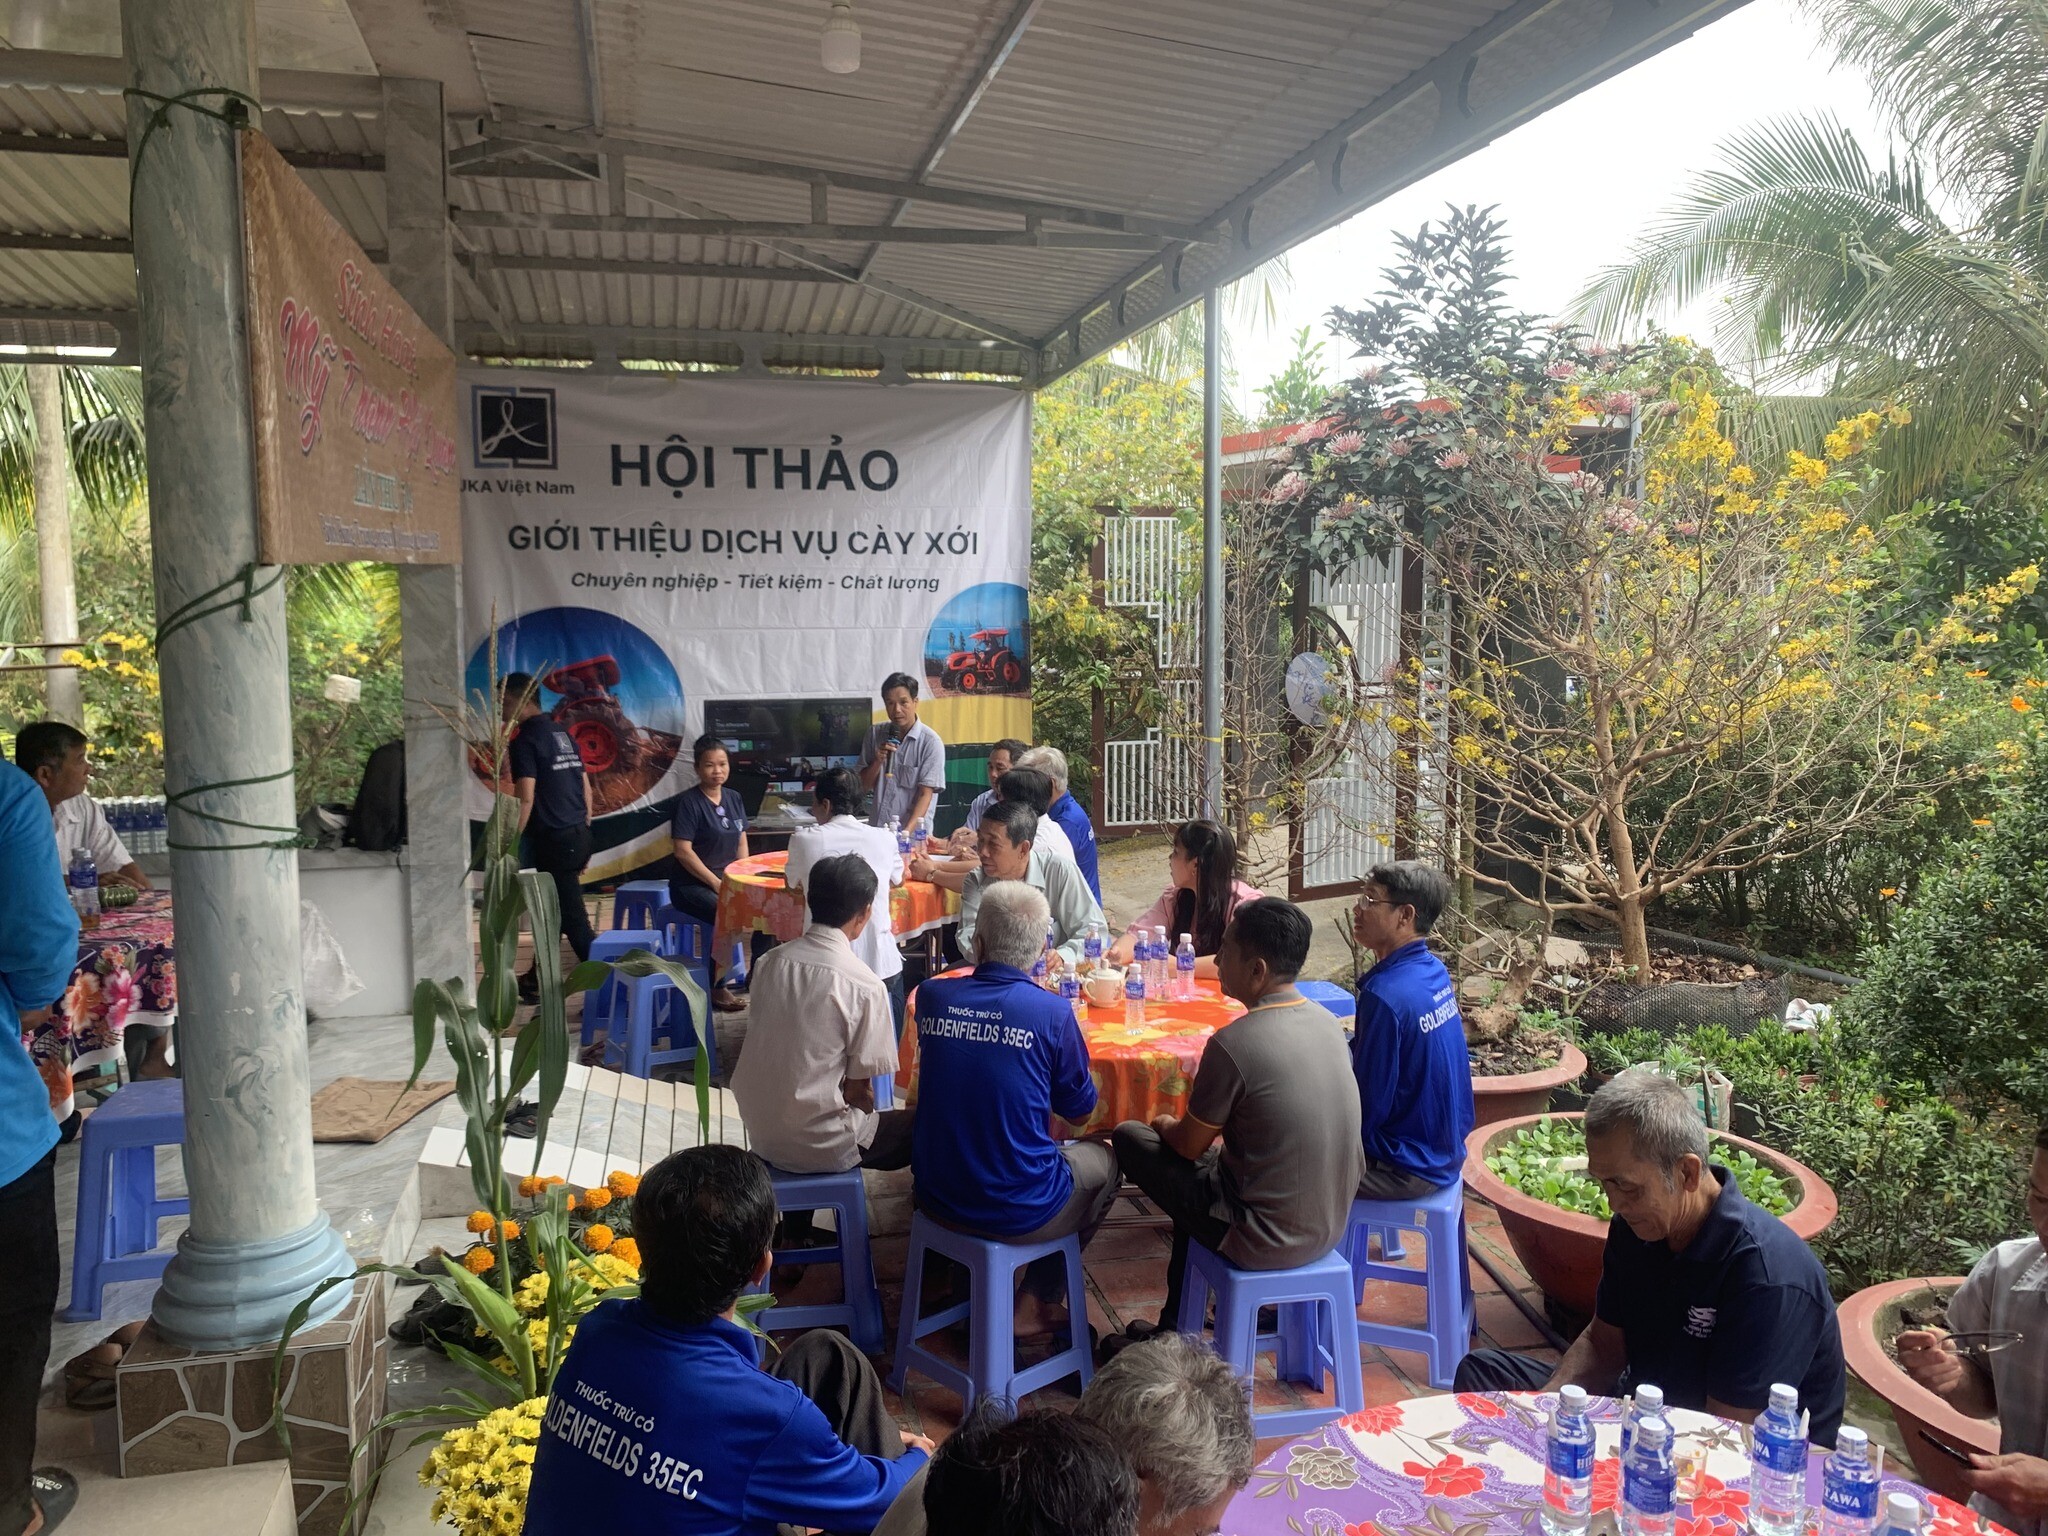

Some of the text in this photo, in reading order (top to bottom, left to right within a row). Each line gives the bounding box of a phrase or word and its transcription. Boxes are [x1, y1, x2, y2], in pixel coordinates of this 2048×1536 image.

[279, 296, 338, 456] Mỹ
[611, 433, 899, 499] HỘI THẢO
[496, 479, 531, 496] Việt
[536, 481, 575, 494] Nam
[508, 519, 978, 560] GIỚI THIỆU DỊCH VỤ CÀY XỚI
[571, 572, 647, 591] Chuyên
[652, 573, 718, 592] nghiệp
[739, 574, 773, 589] Tiết
[778, 574, 822, 592] kiệm
[841, 575, 882, 589] Chất
[888, 575, 939, 592] lượng
[947, 1005, 1003, 1020] THUỐC TRỪ CỎ
[920, 1017, 1034, 1050] GOLDENFIELDS 35EC
[575, 1380, 655, 1433] THUỐC TRỪ CỎ
[643, 1451, 704, 1501] 35EC
[1824, 1485, 1861, 1508] TAWA
